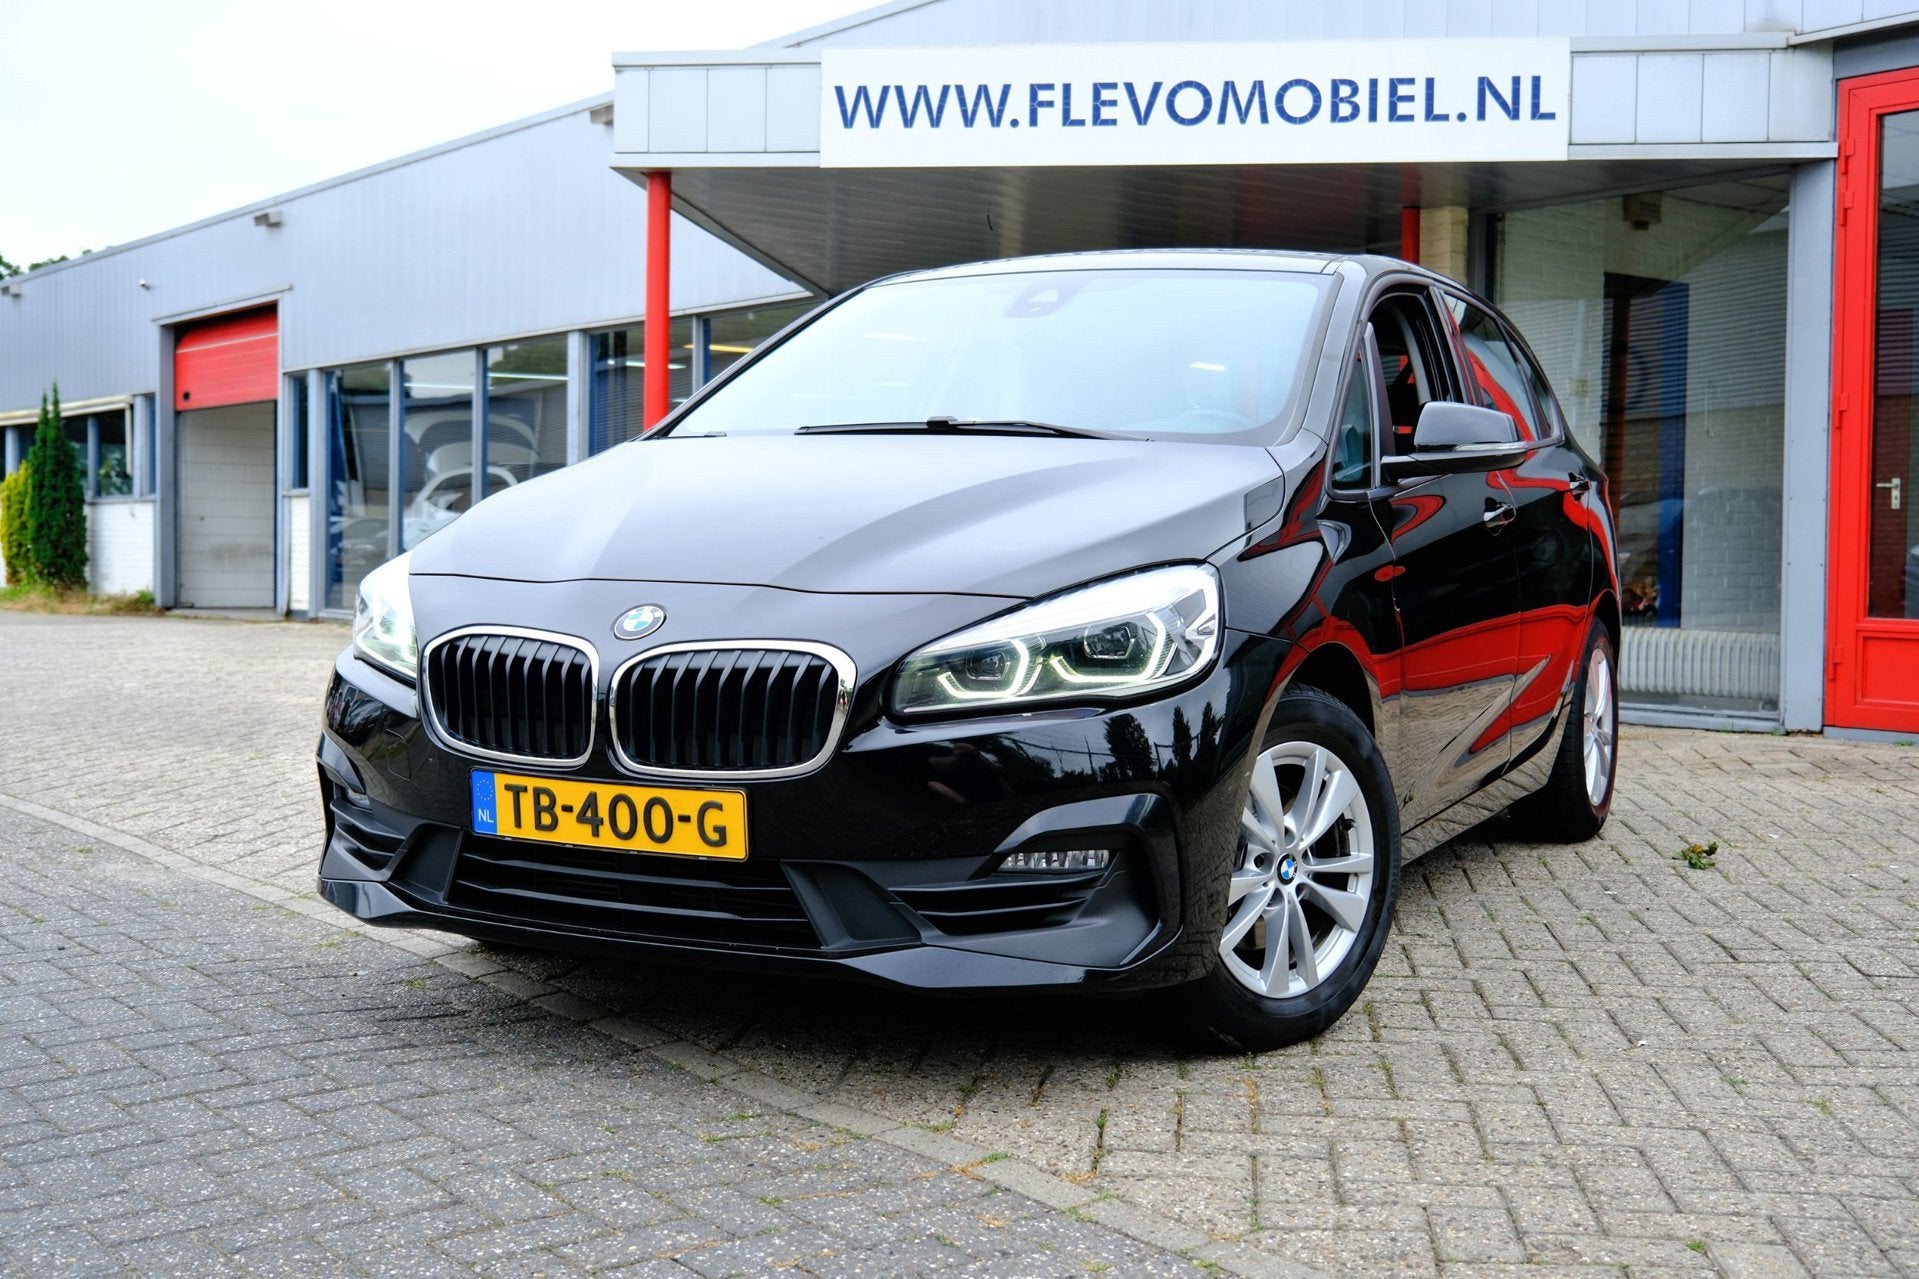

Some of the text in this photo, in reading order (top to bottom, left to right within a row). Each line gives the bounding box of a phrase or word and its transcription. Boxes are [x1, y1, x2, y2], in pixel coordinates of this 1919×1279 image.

[834, 75, 1556, 129] WWW.FLEVOMOBIEL.NL
[478, 808, 495, 823] NL
[504, 783, 728, 848] TB-400-G
